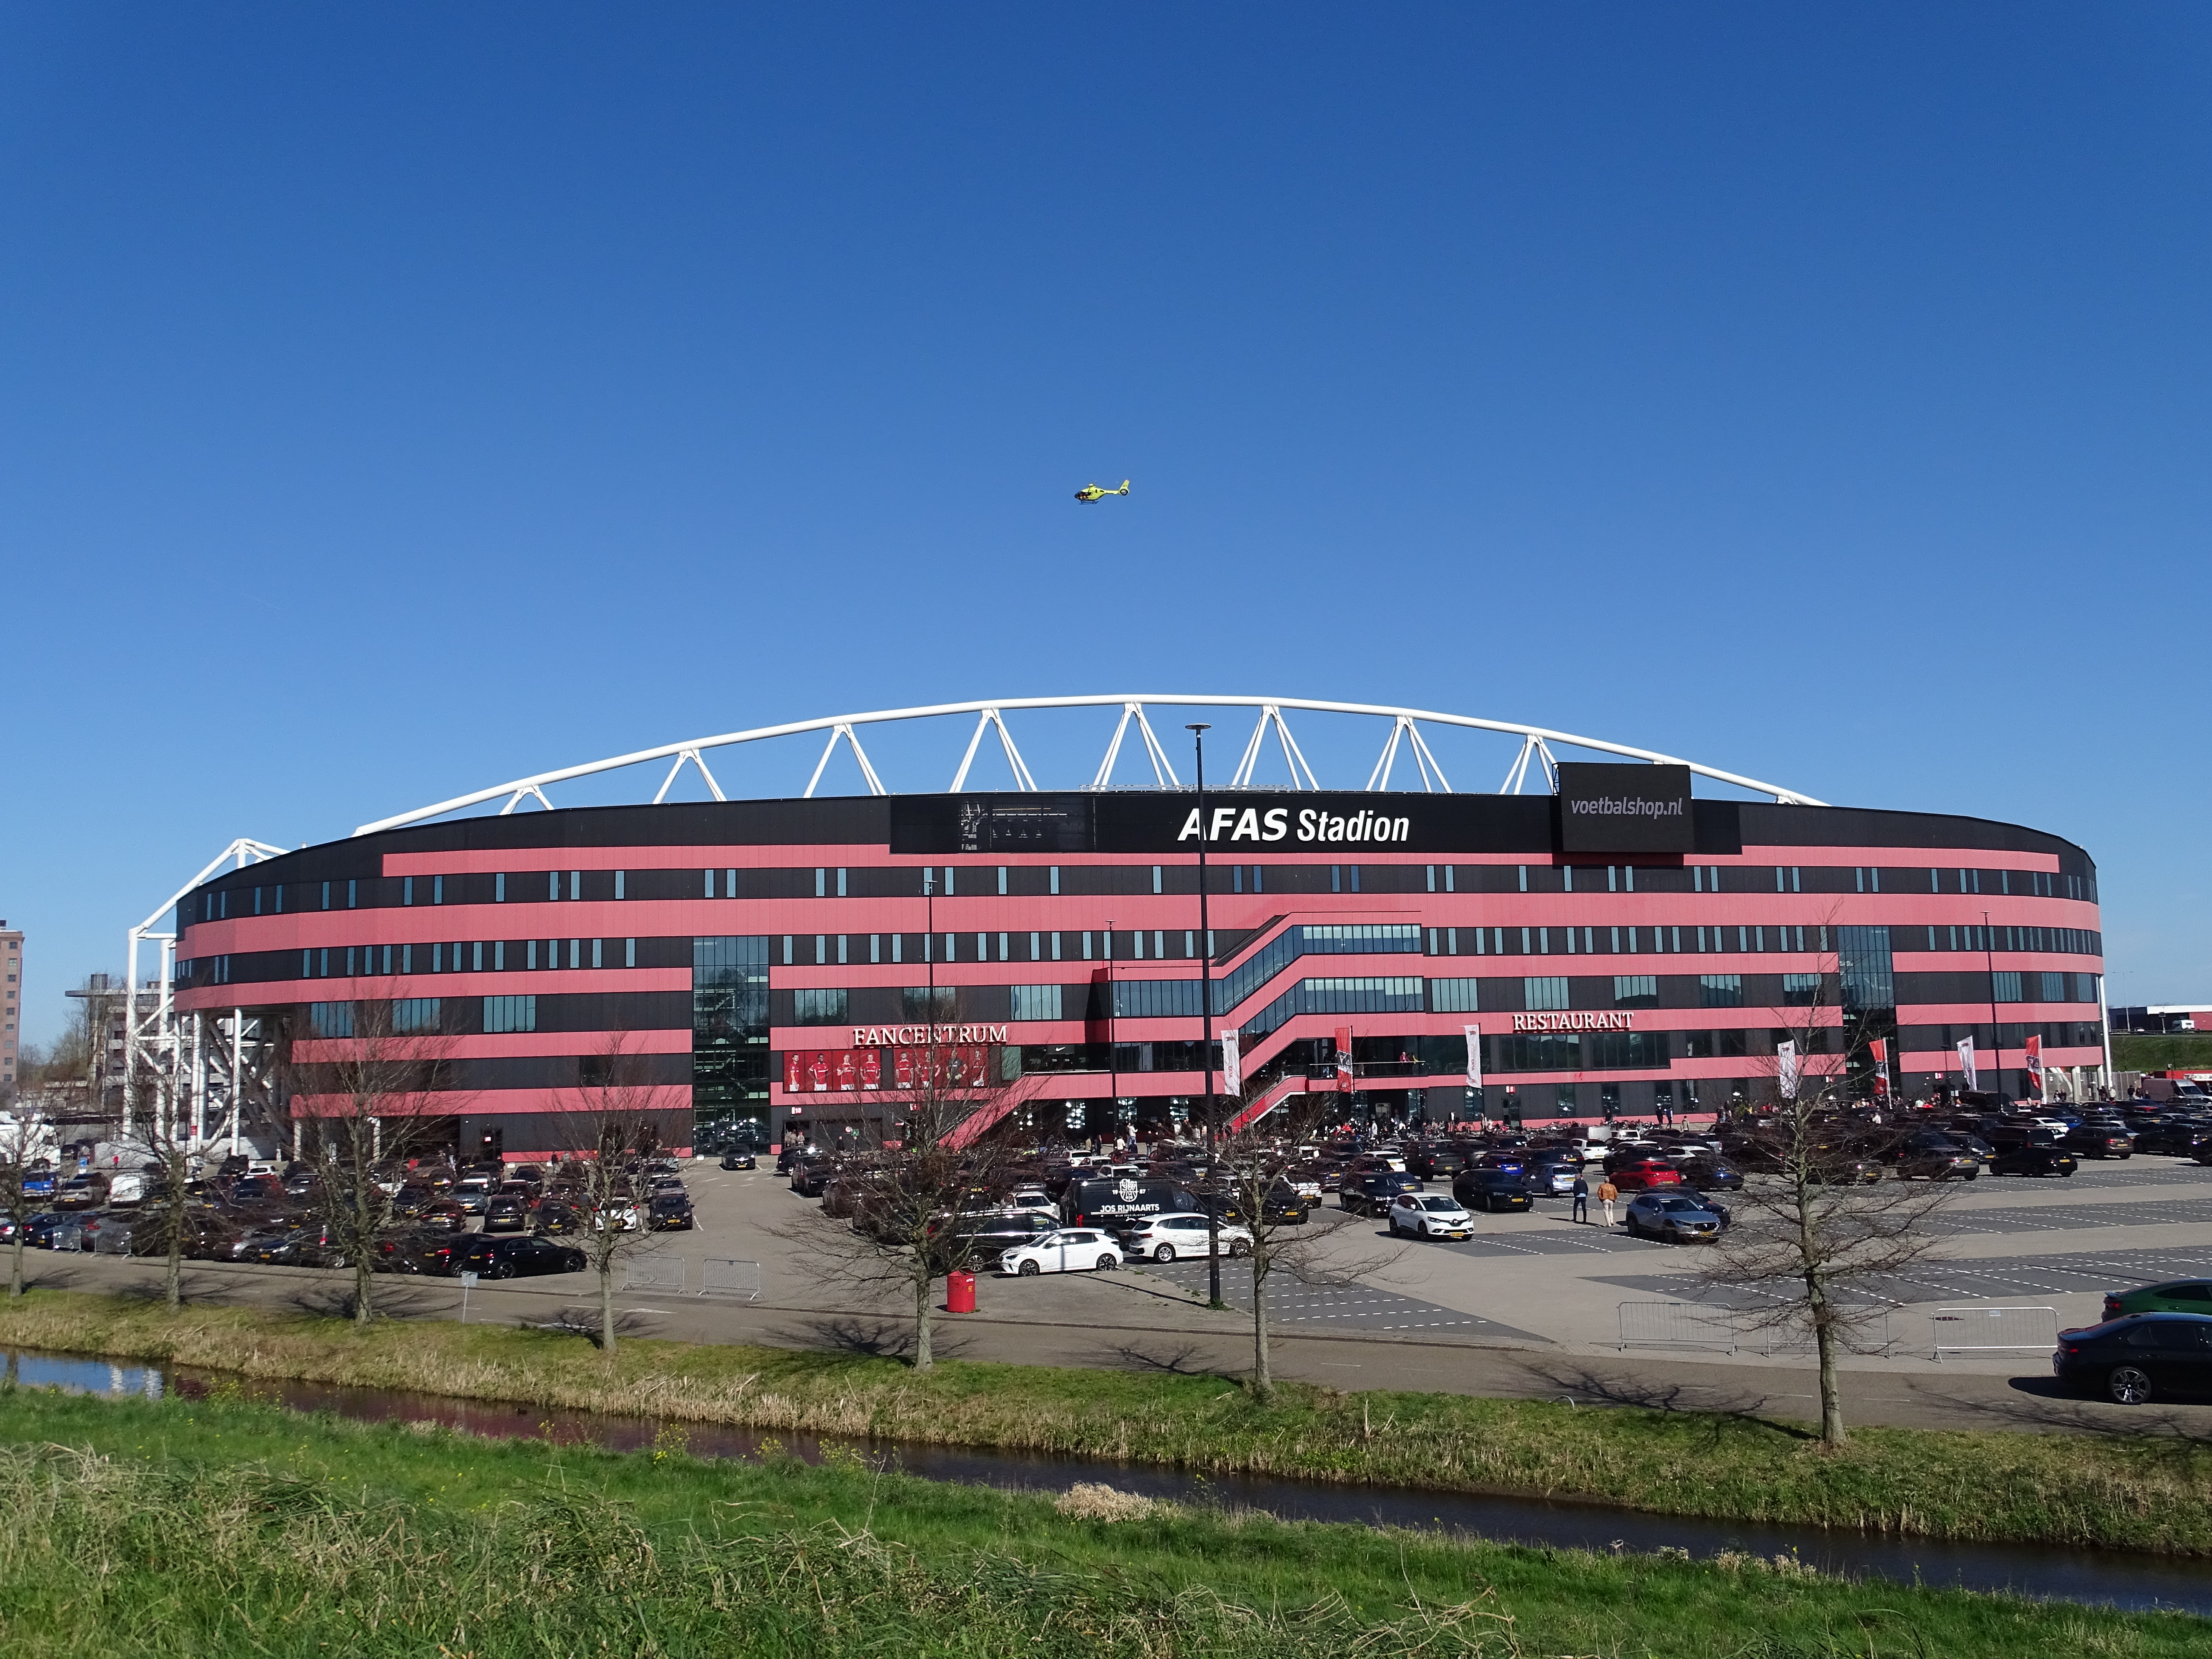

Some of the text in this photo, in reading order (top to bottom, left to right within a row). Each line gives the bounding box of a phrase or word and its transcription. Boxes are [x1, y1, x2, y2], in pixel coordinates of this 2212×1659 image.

[1571, 796, 1682, 820] voetbalshop.nl
[1177, 808, 1409, 841] AFAS Stadion
[1513, 1012, 1634, 1030] RESTAURANT
[854, 1025, 1007, 1045] FANCENTRUM
[1100, 1203, 1160, 1213] JOS RIJNAARTS
